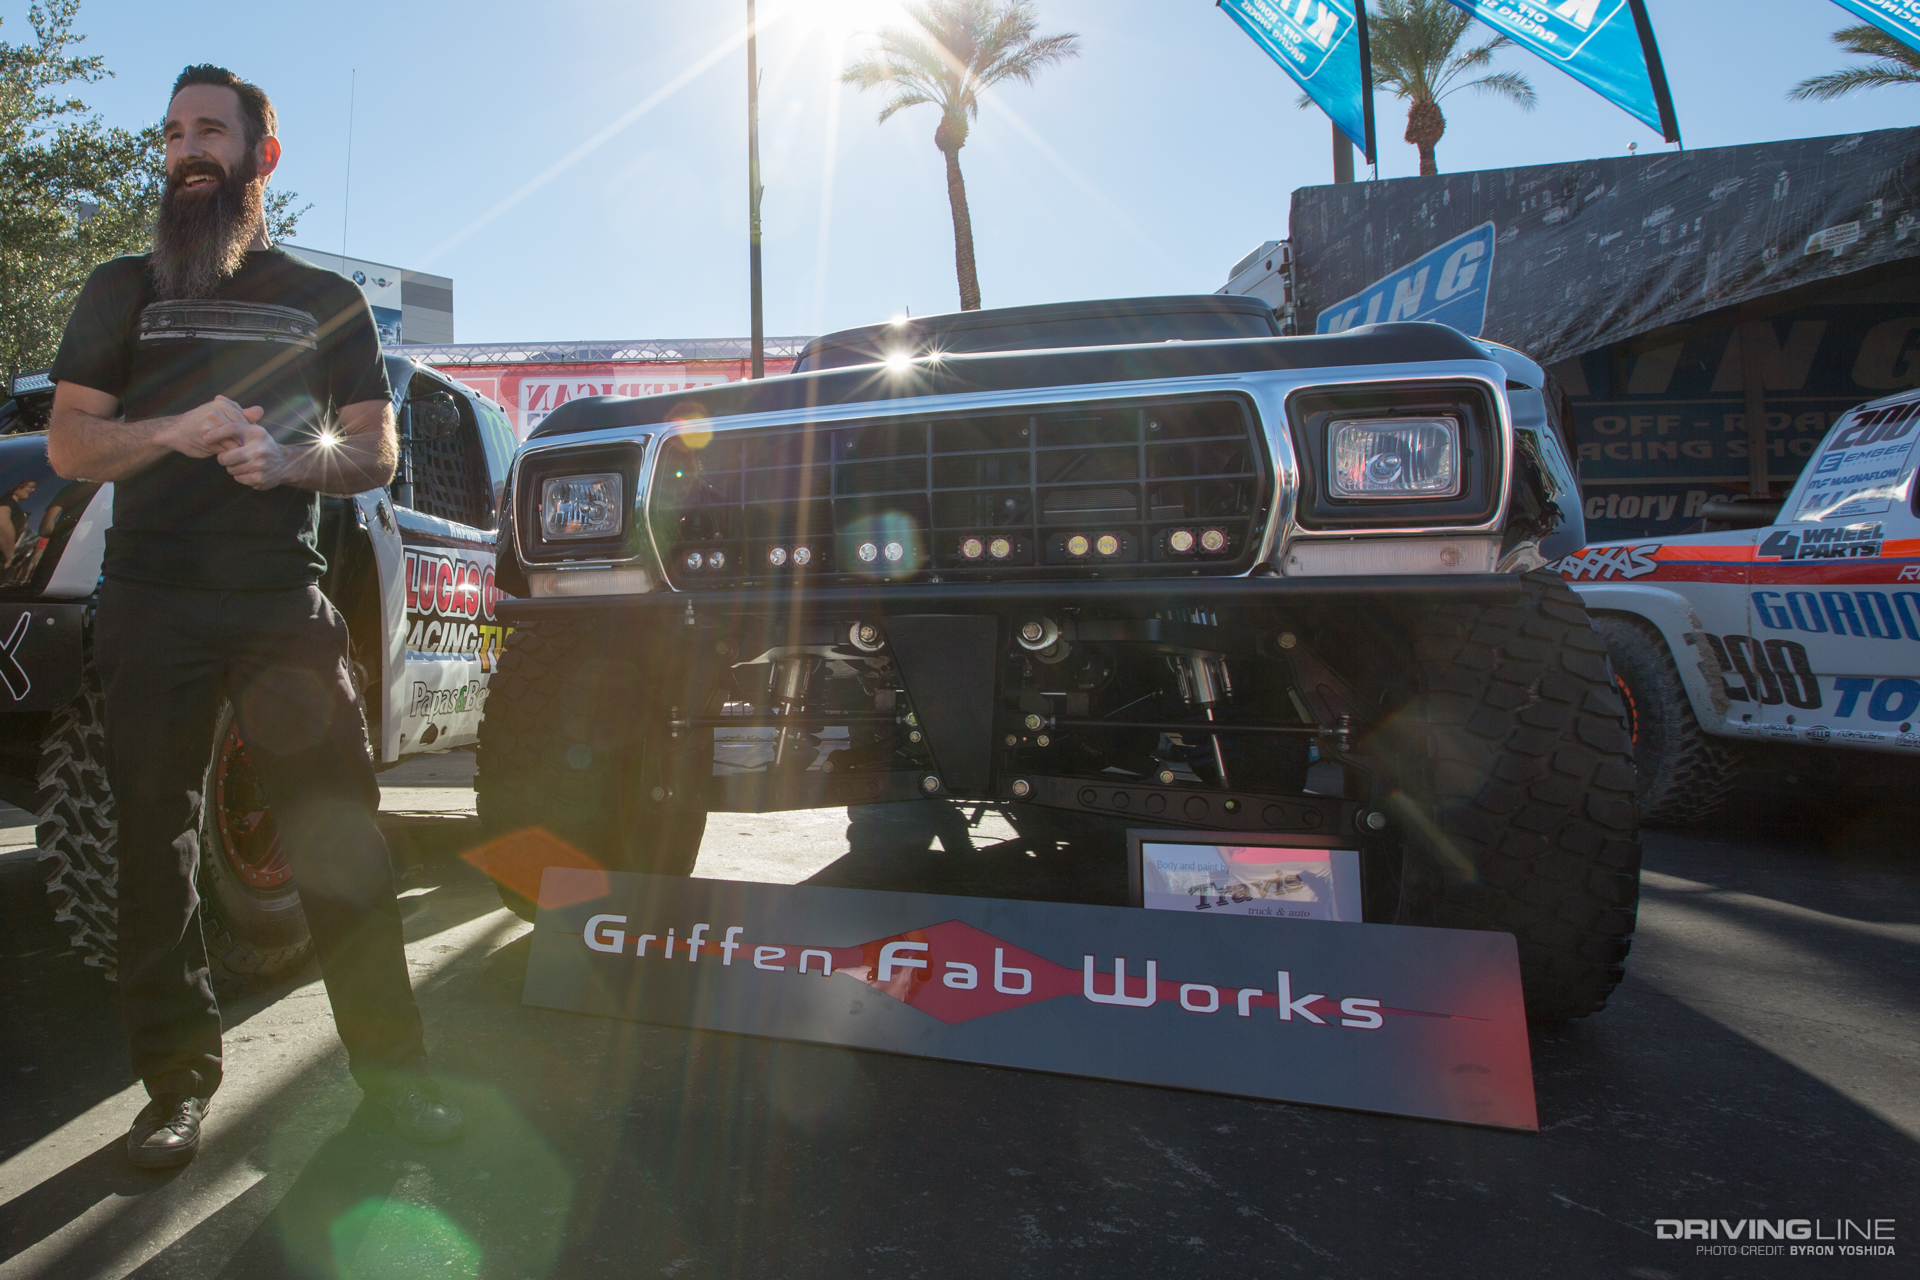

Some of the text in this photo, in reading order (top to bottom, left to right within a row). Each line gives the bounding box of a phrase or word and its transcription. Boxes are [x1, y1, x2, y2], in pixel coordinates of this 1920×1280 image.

[1592, 413, 1681, 436] OFF
[1723, 411, 1842, 433] ROA
[1578, 439, 1712, 462] ACING
[1843, 443, 1914, 463] EMBEE
[1829, 467, 1901, 487] MAGNAFLOW
[1585, 491, 1678, 521] ctory
[1757, 522, 1885, 560] 4 WHEEL
[1797, 540, 1877, 559] PARTS
[1545, 544, 1663, 581] AXXAS
[406, 552, 481, 621] LUCAS
[406, 620, 481, 655] ACING
[1157, 860, 1231, 874] Body and paint by
[1187, 869, 1304, 910] Travis
[1248, 906, 1311, 918] truck & auto
[582, 913, 1385, 1030] Griffen Fab Works
